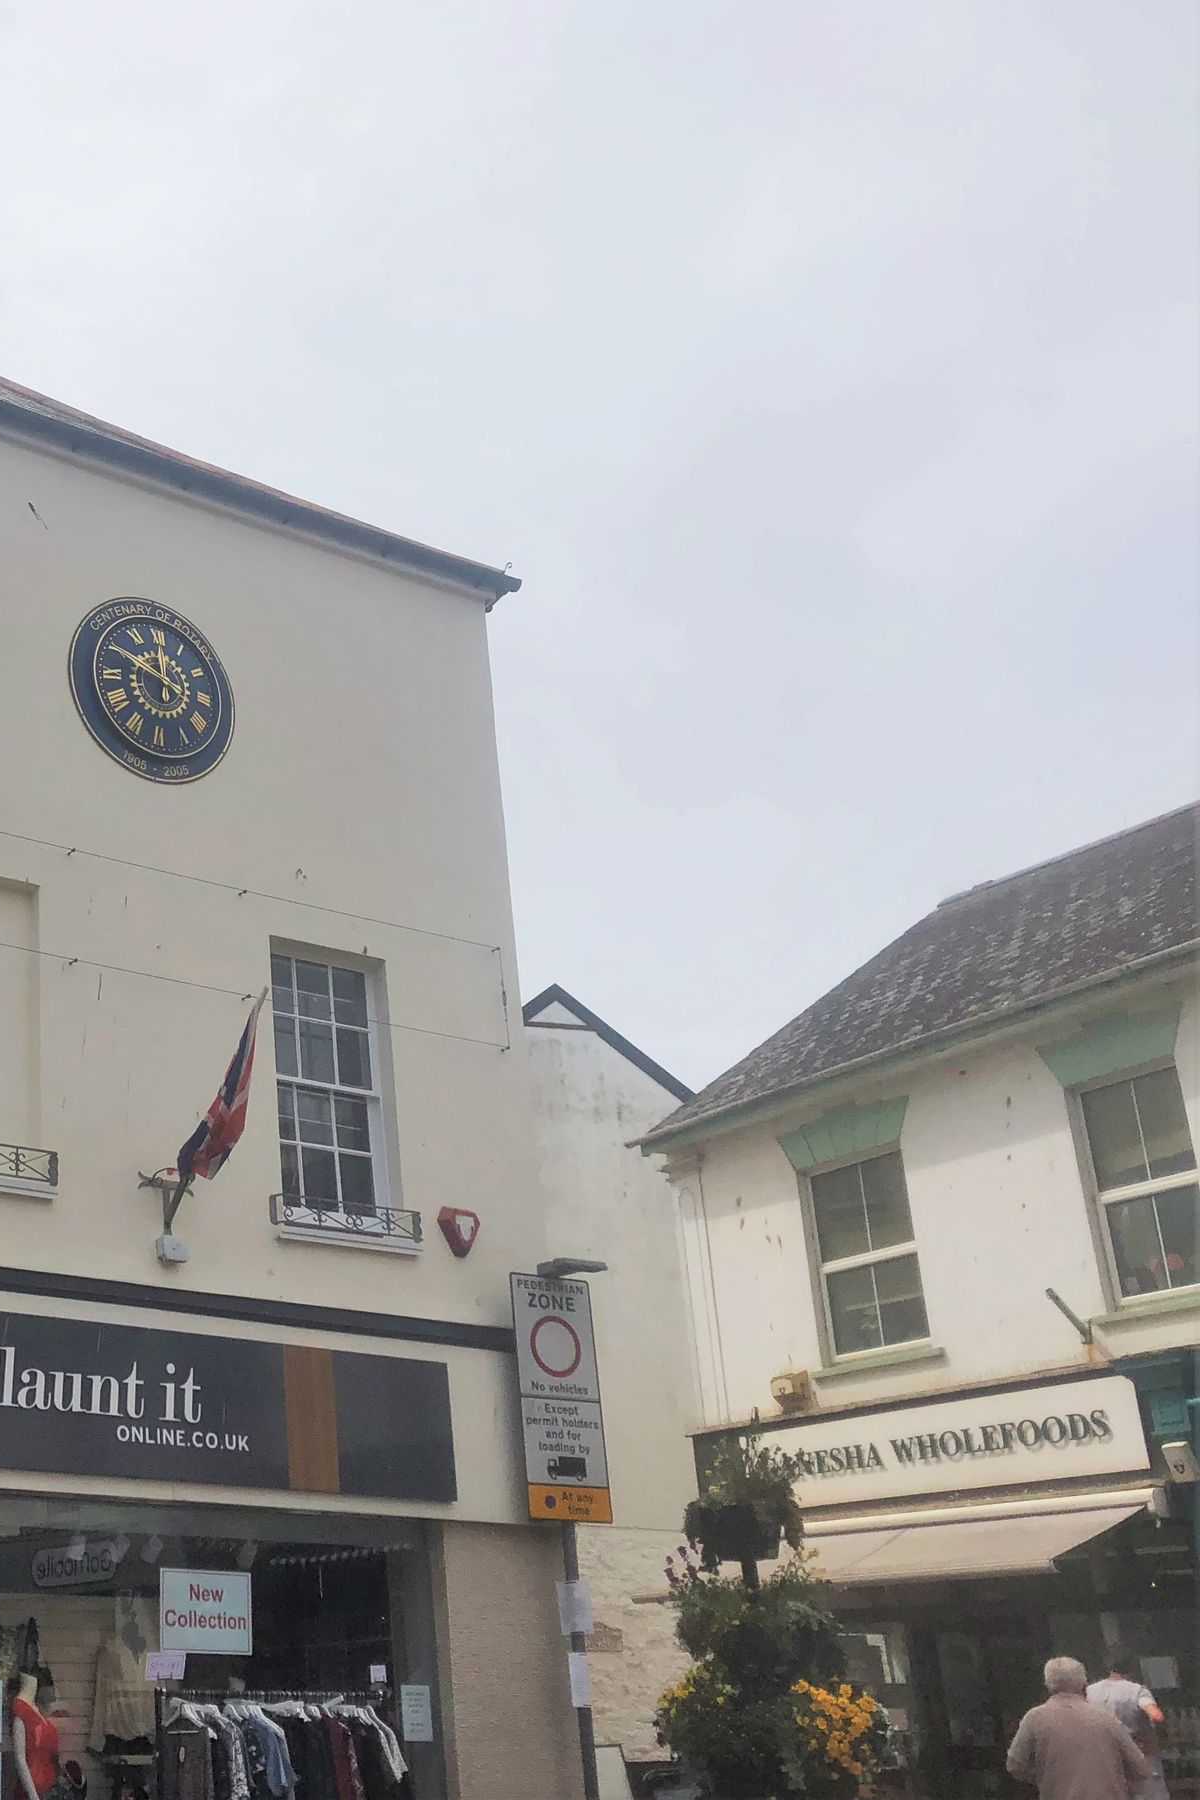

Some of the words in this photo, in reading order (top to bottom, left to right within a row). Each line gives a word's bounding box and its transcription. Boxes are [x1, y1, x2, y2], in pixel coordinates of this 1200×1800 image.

[90, 604, 152, 630] CENTENARY
[155, 609, 171, 623] OF
[173, 618, 214, 662] ROTARY
[123, 750, 148, 771] 1905
[164, 764, 189, 777] 2005
[517, 1279, 584, 1295] PEDESTRIAN
[528, 1292, 576, 1312] ZONE
[158, 1362, 202, 1424] it
[531, 1381, 546, 1391] No
[549, 1383, 589, 1395] vehicles
[544, 1403, 579, 1416] Except
[526, 1416, 560, 1427] permit
[562, 1418, 599, 1430] holders
[116, 1424, 250, 1452] ONLINE.CO.UK
[545, 1430, 564, 1440] and
[567, 1430, 582, 1441] for
[791, 1442, 884, 1476] NESHA
[890, 1409, 1112, 1463] WHOLEFOODS
[538, 1441, 576, 1455] loading
[579, 1444, 591, 1456] by
[561, 1491, 574, 1501] At
[576, 1494, 594, 1505] any
[568, 1505, 590, 1515] time
[189, 1583, 224, 1602] New
[164, 1608, 247, 1631] Collection
